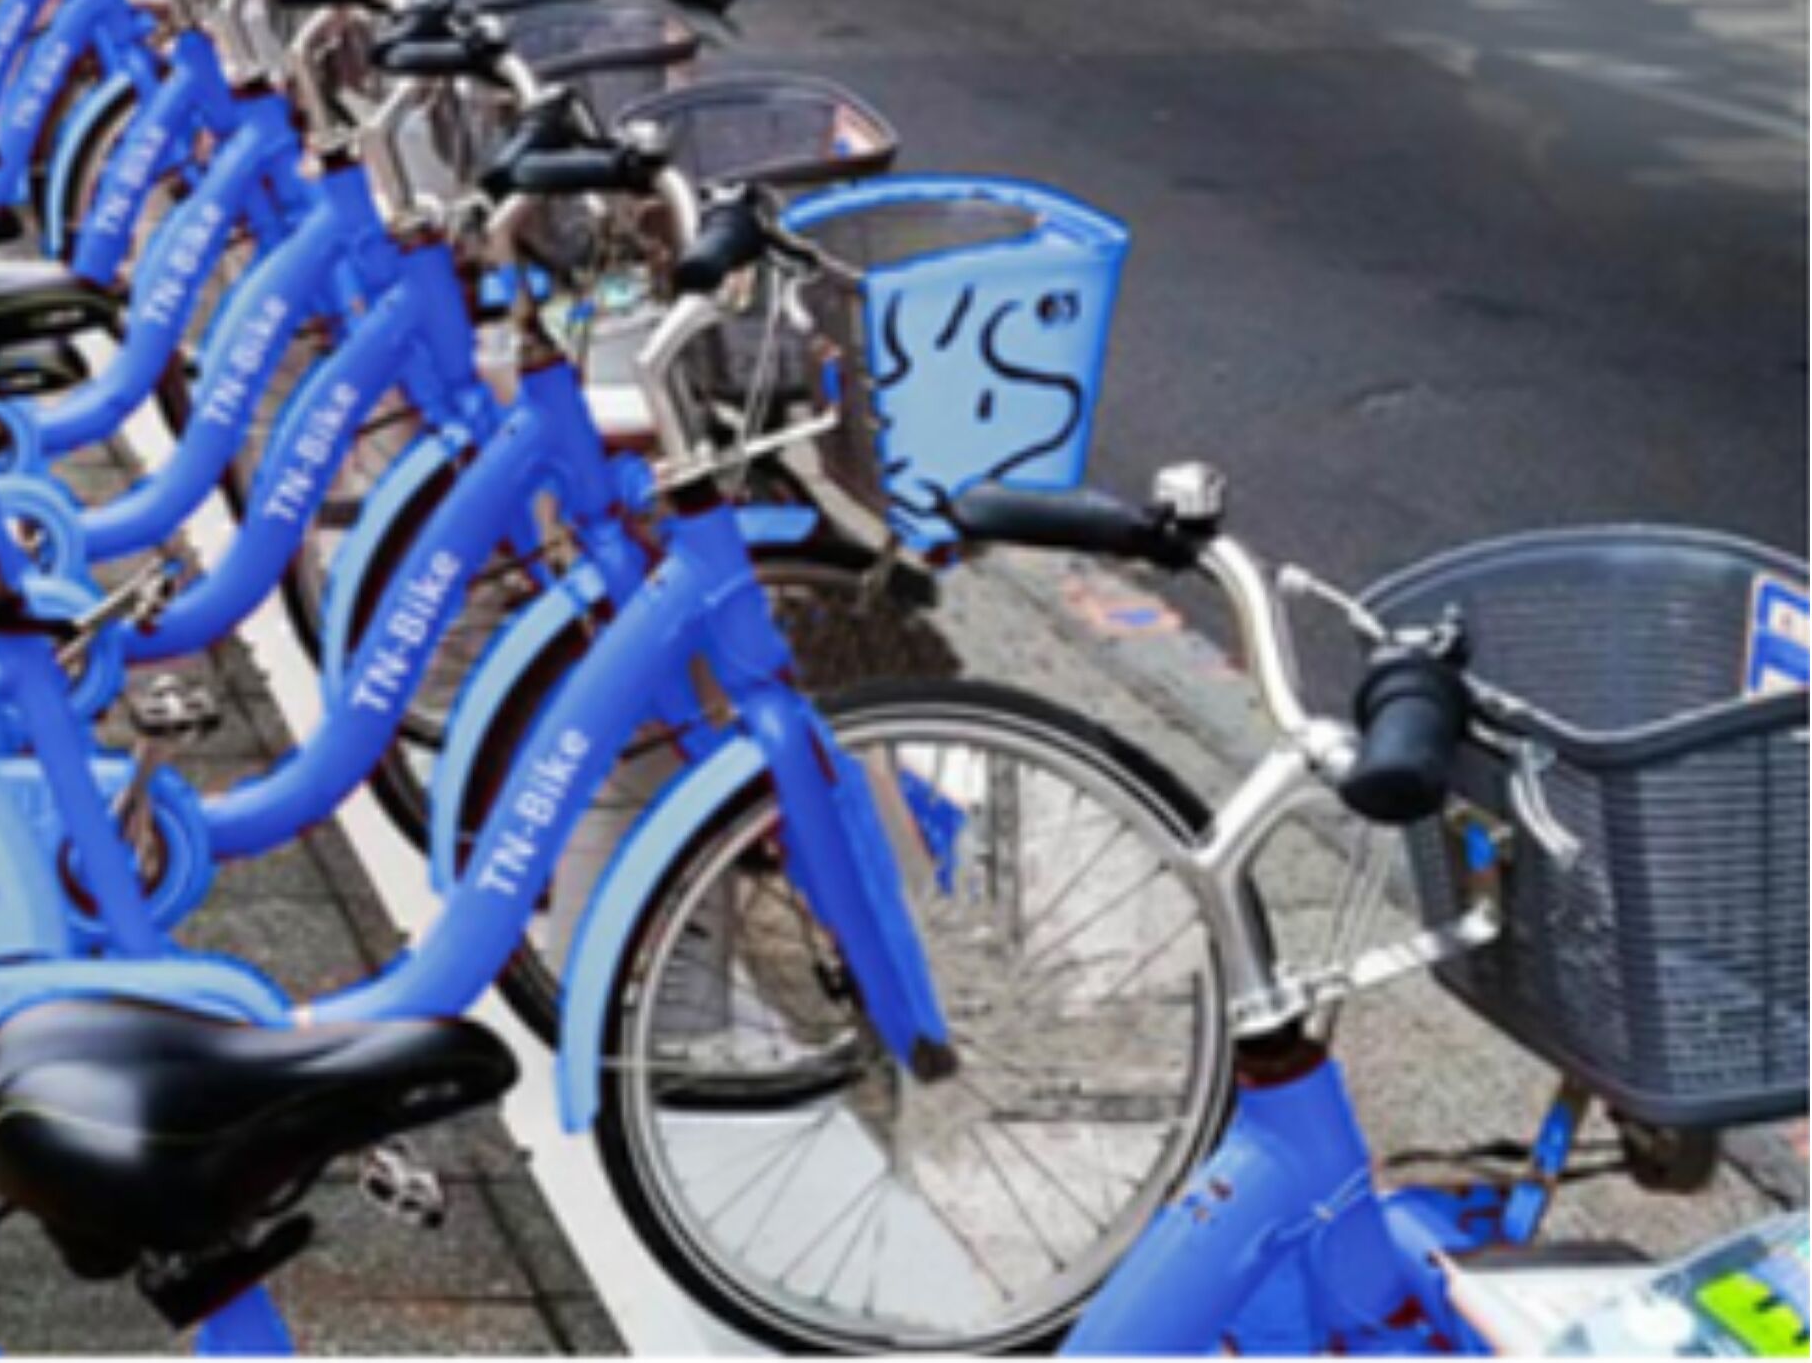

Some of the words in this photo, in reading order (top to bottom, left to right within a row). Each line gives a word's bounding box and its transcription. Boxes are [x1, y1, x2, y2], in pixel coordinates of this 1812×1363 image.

[140, 203, 224, 325] TN-Bike
[204, 296, 287, 426] TN-Bike
[264, 382, 360, 521] TN-Bike
[352, 550, 463, 714] TN-Bike
[479, 728, 590, 896] TN-Bike
